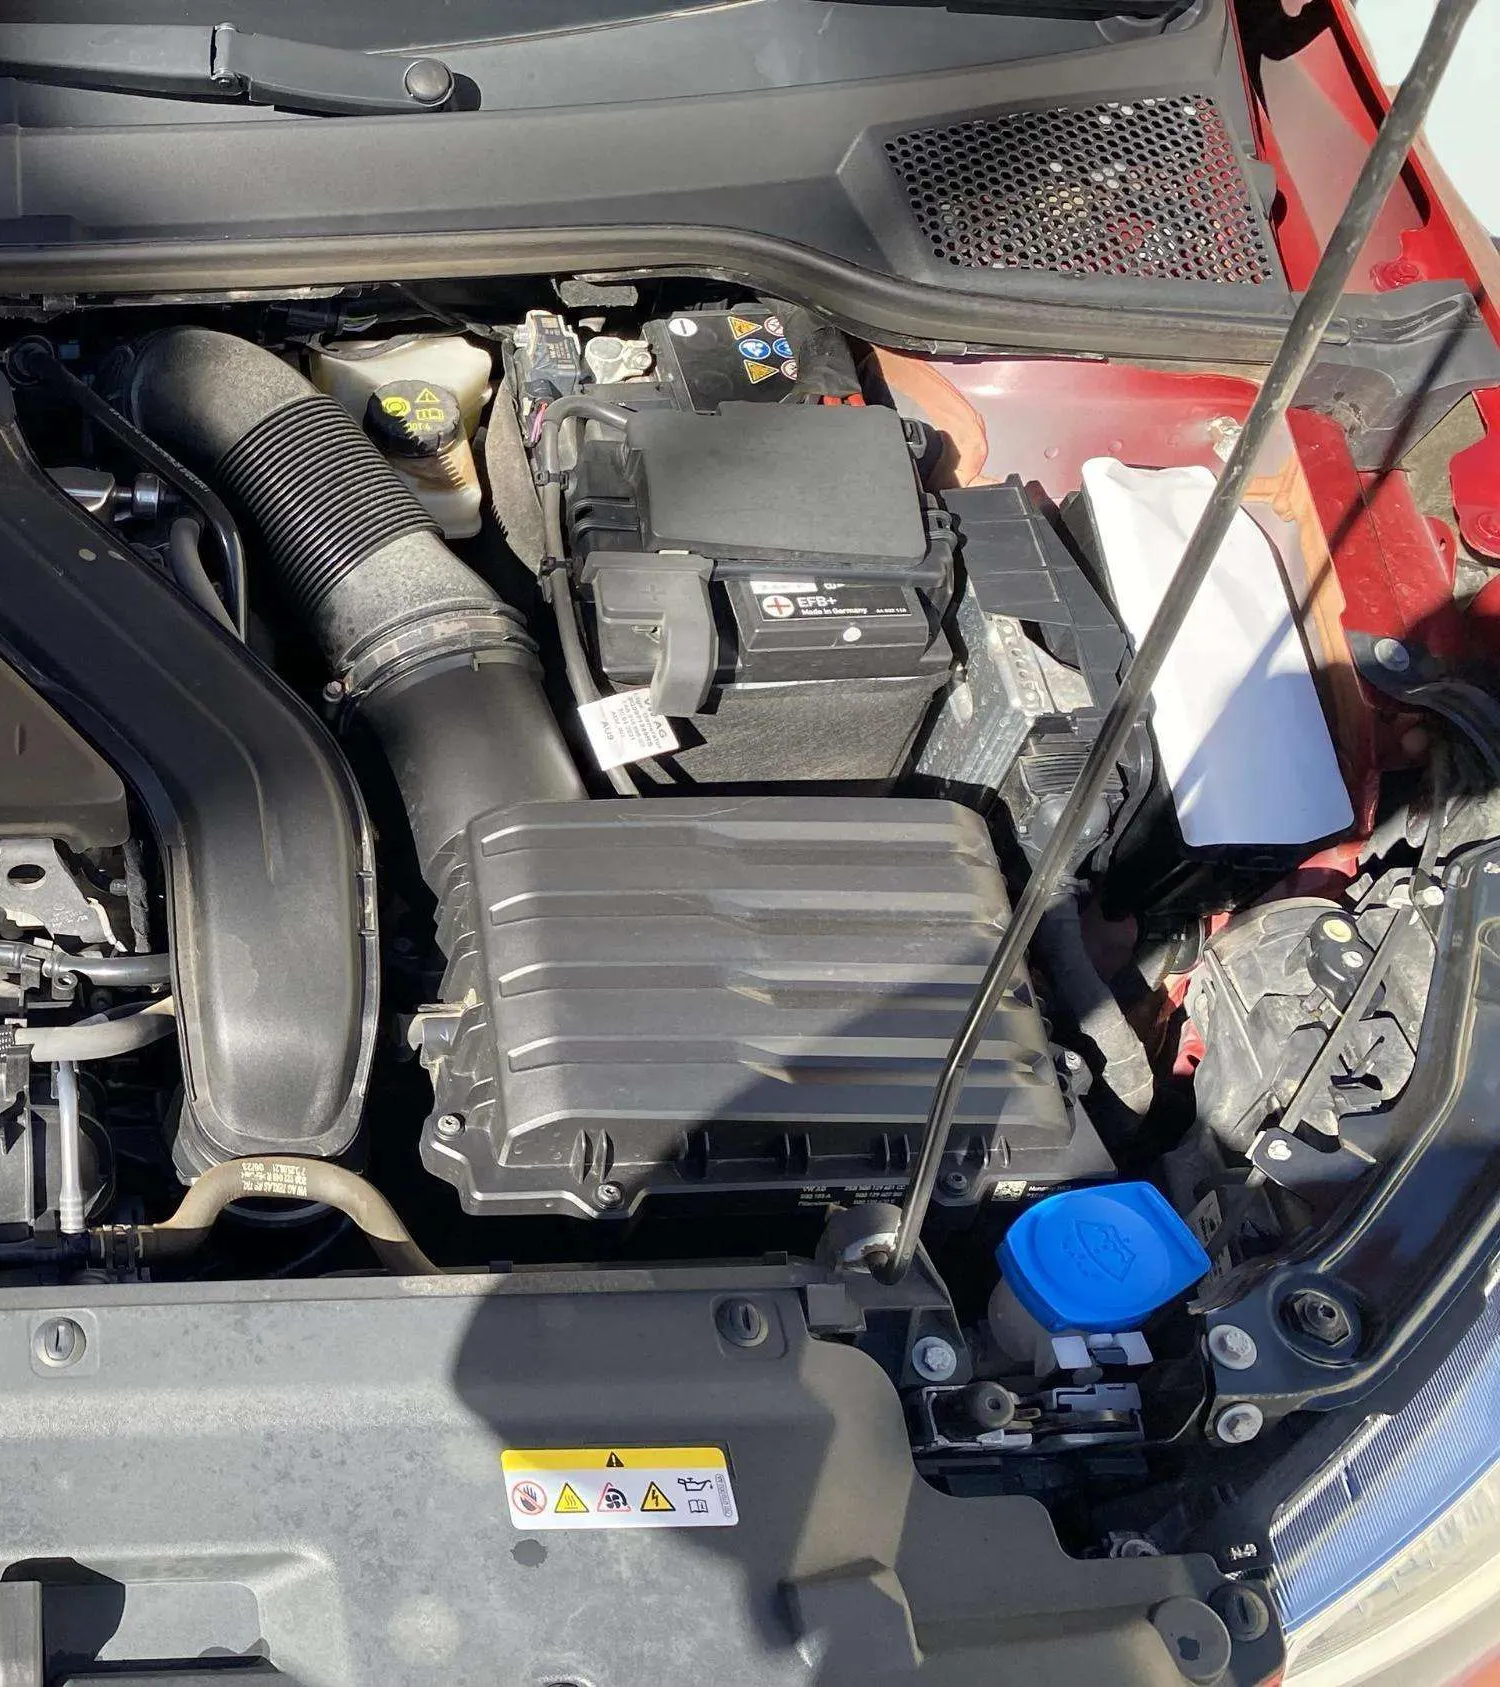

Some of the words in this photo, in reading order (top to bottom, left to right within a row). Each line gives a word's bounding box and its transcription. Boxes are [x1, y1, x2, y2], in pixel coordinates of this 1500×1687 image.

[796, 596, 838, 608] EFB+
[801, 608, 822, 616] Made
[833, 607, 868, 616] Germany
[654, 721, 667, 739] AG
